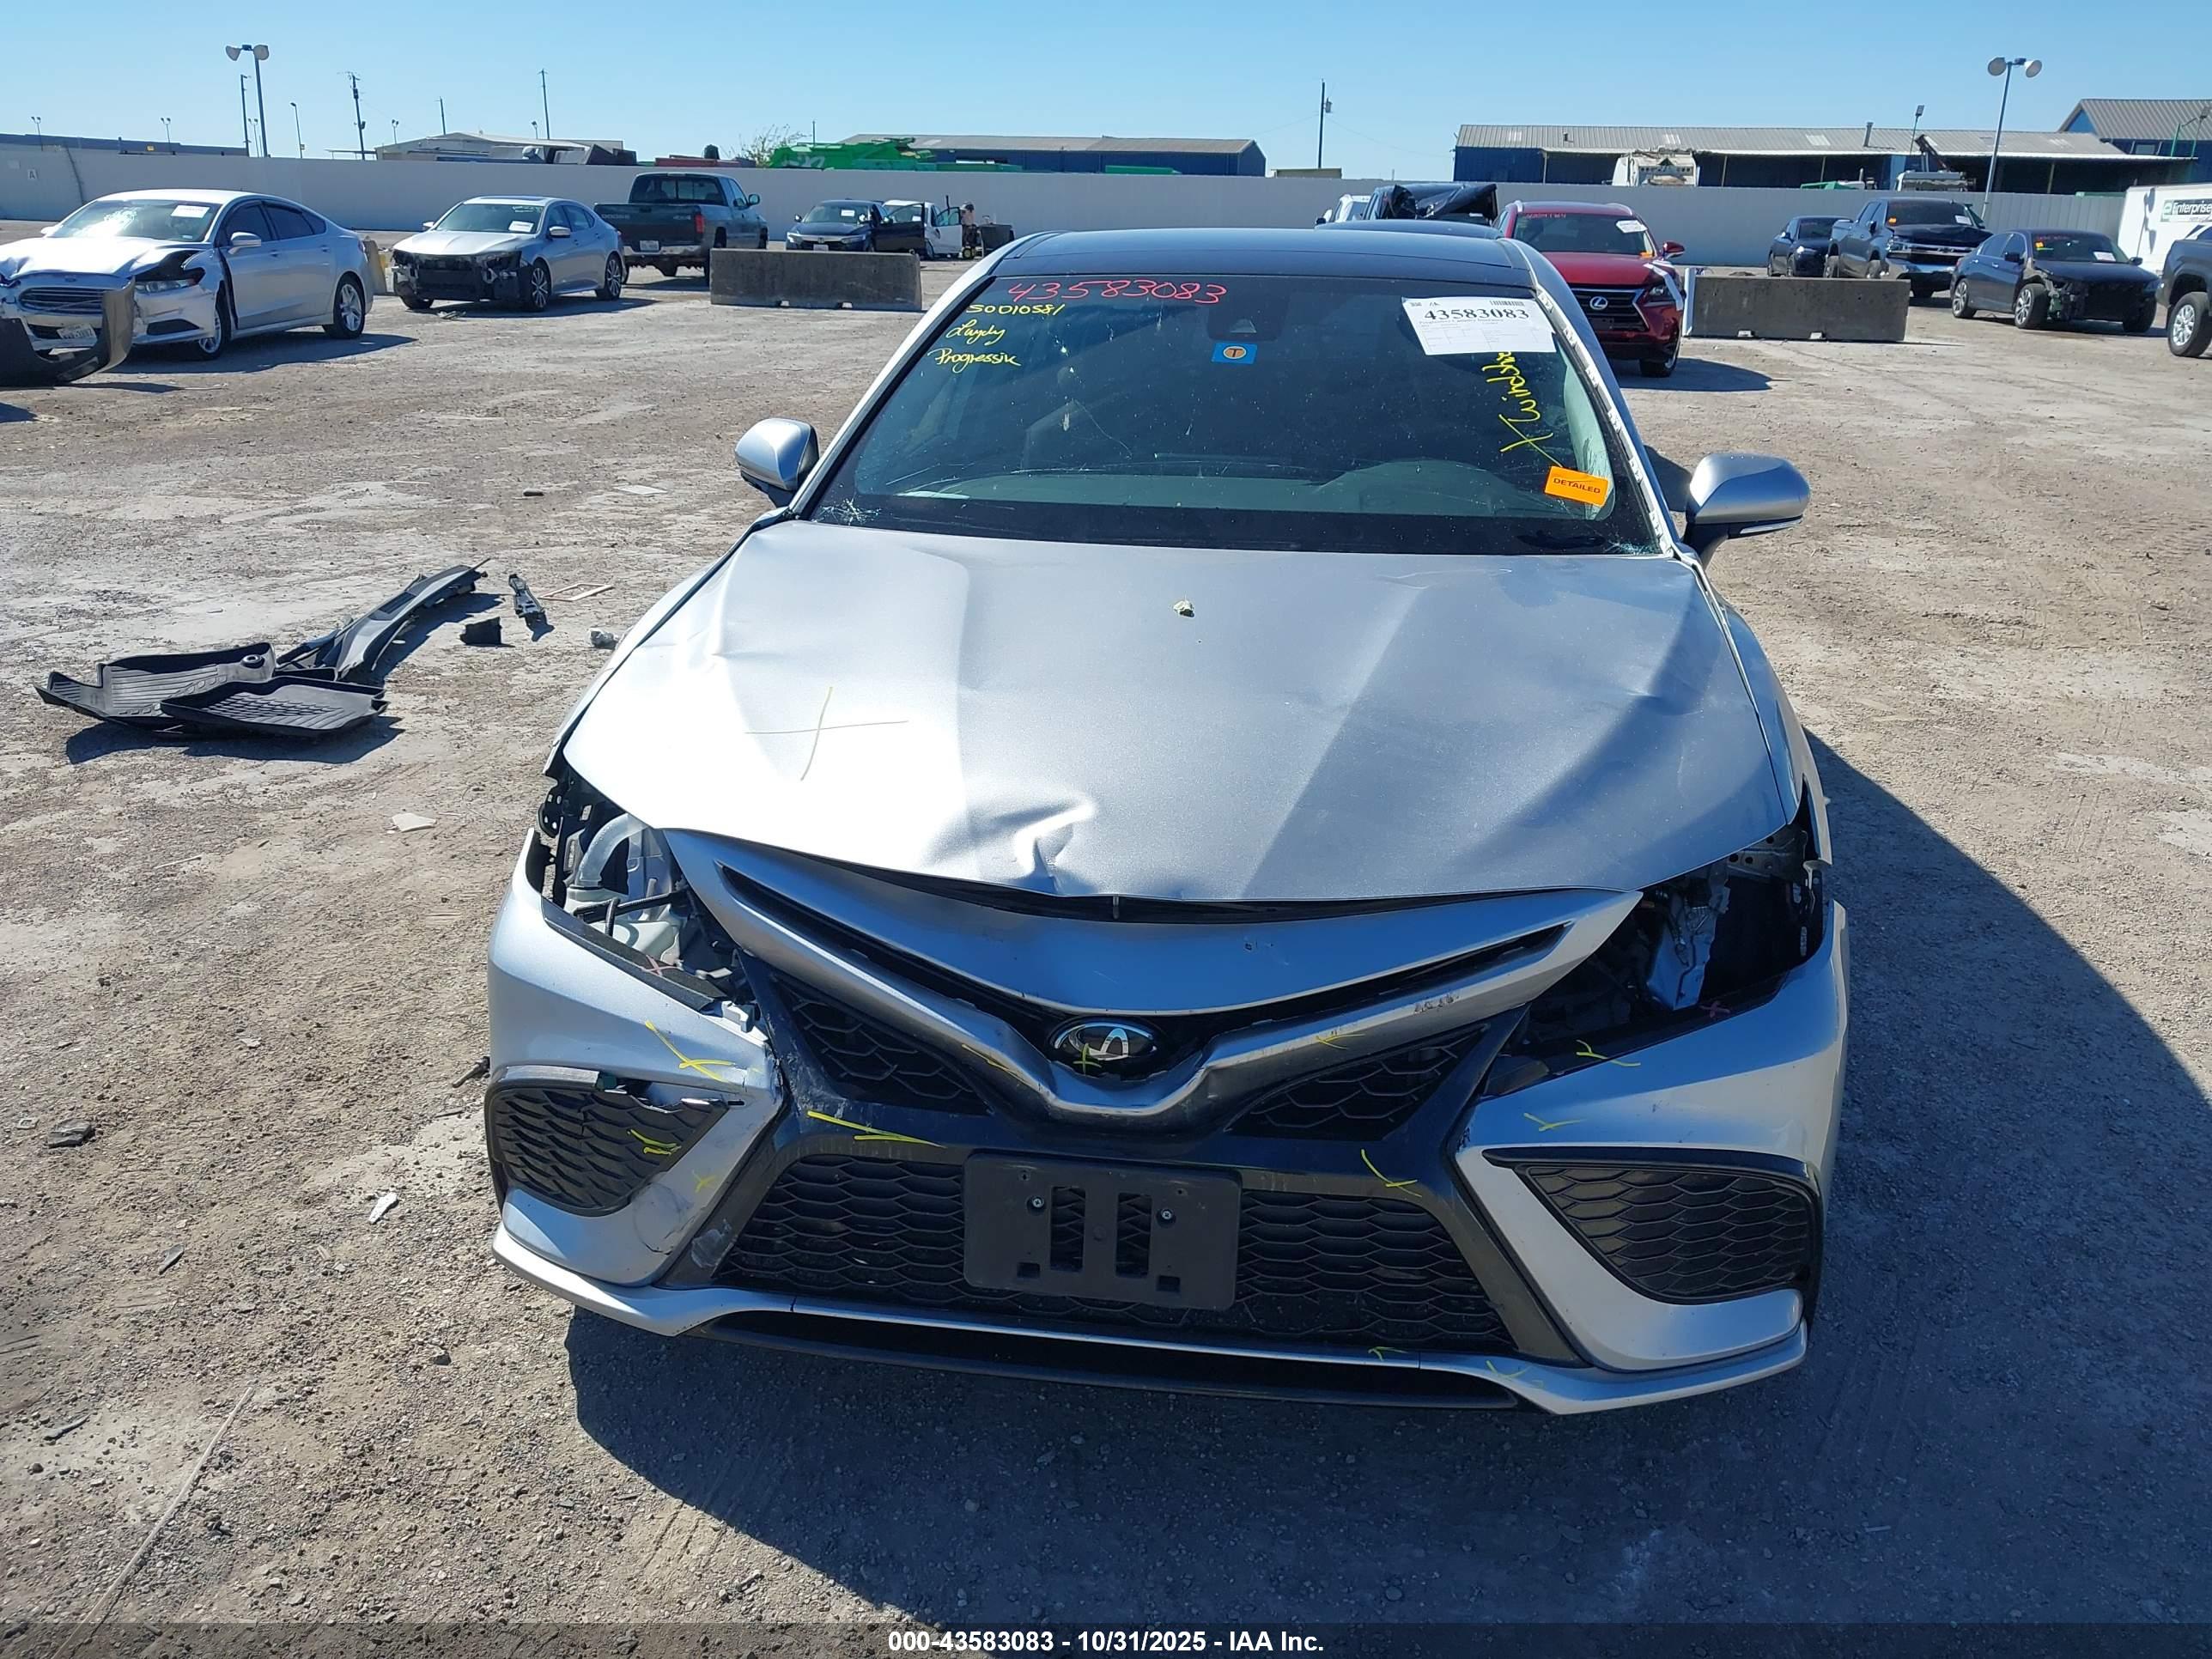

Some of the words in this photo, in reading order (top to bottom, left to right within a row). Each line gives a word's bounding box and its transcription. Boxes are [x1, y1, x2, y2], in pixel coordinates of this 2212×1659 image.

[2172, 200, 2212, 215] Enterprise
[1008, 279, 1227, 304] 43583083
[1424, 308, 1530, 320] 43583083
[1553, 477, 1601, 494] DETAILED
